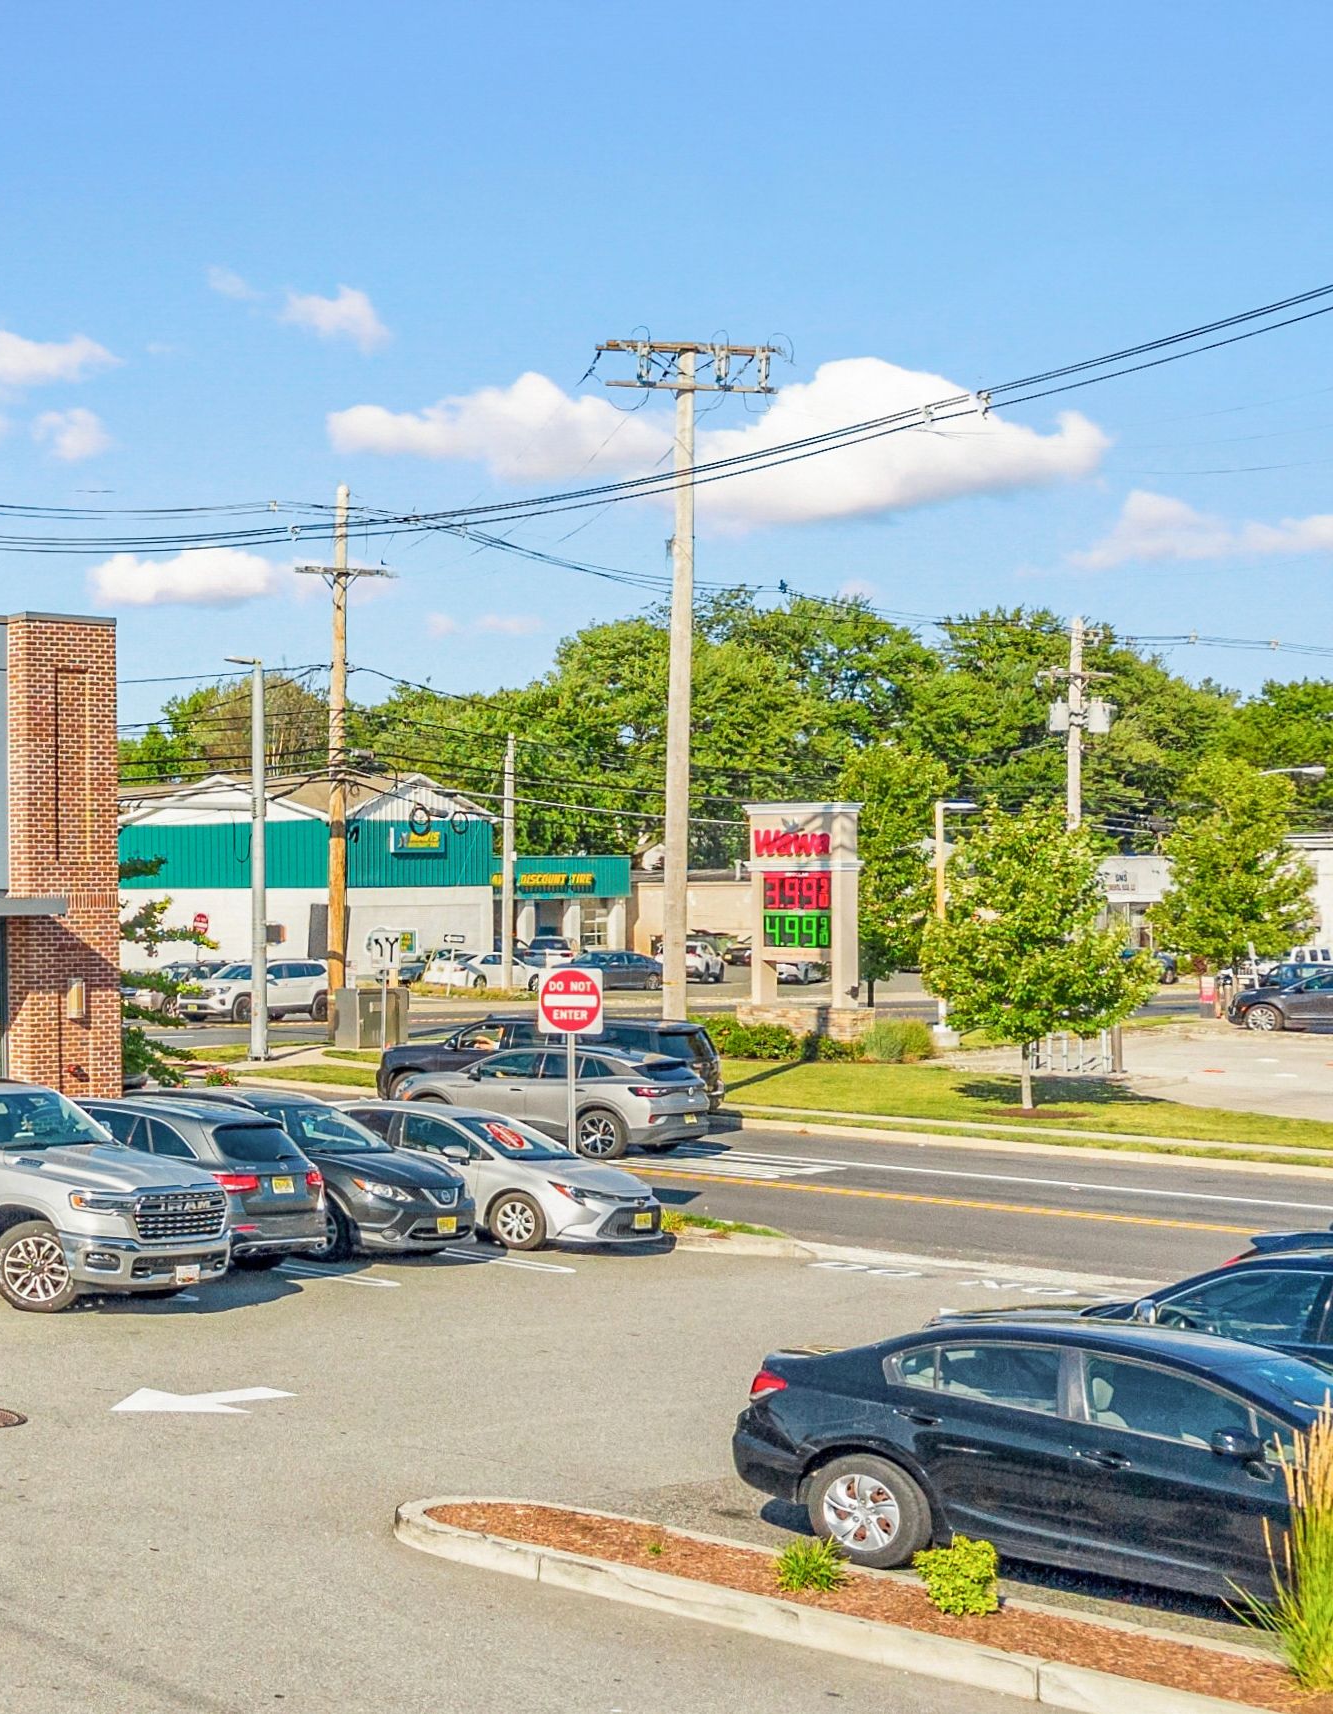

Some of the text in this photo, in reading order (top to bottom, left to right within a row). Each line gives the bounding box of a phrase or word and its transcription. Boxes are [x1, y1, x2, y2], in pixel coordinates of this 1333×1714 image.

[754, 829, 831, 857] Wawa
[520, 874, 593, 886] DISCOUNT TIRE
[765, 878, 818, 908] 3.99
[765, 917, 818, 947] 4.99
[549, 981, 592, 992] DO NOT
[553, 1009, 588, 1020] ENTER
